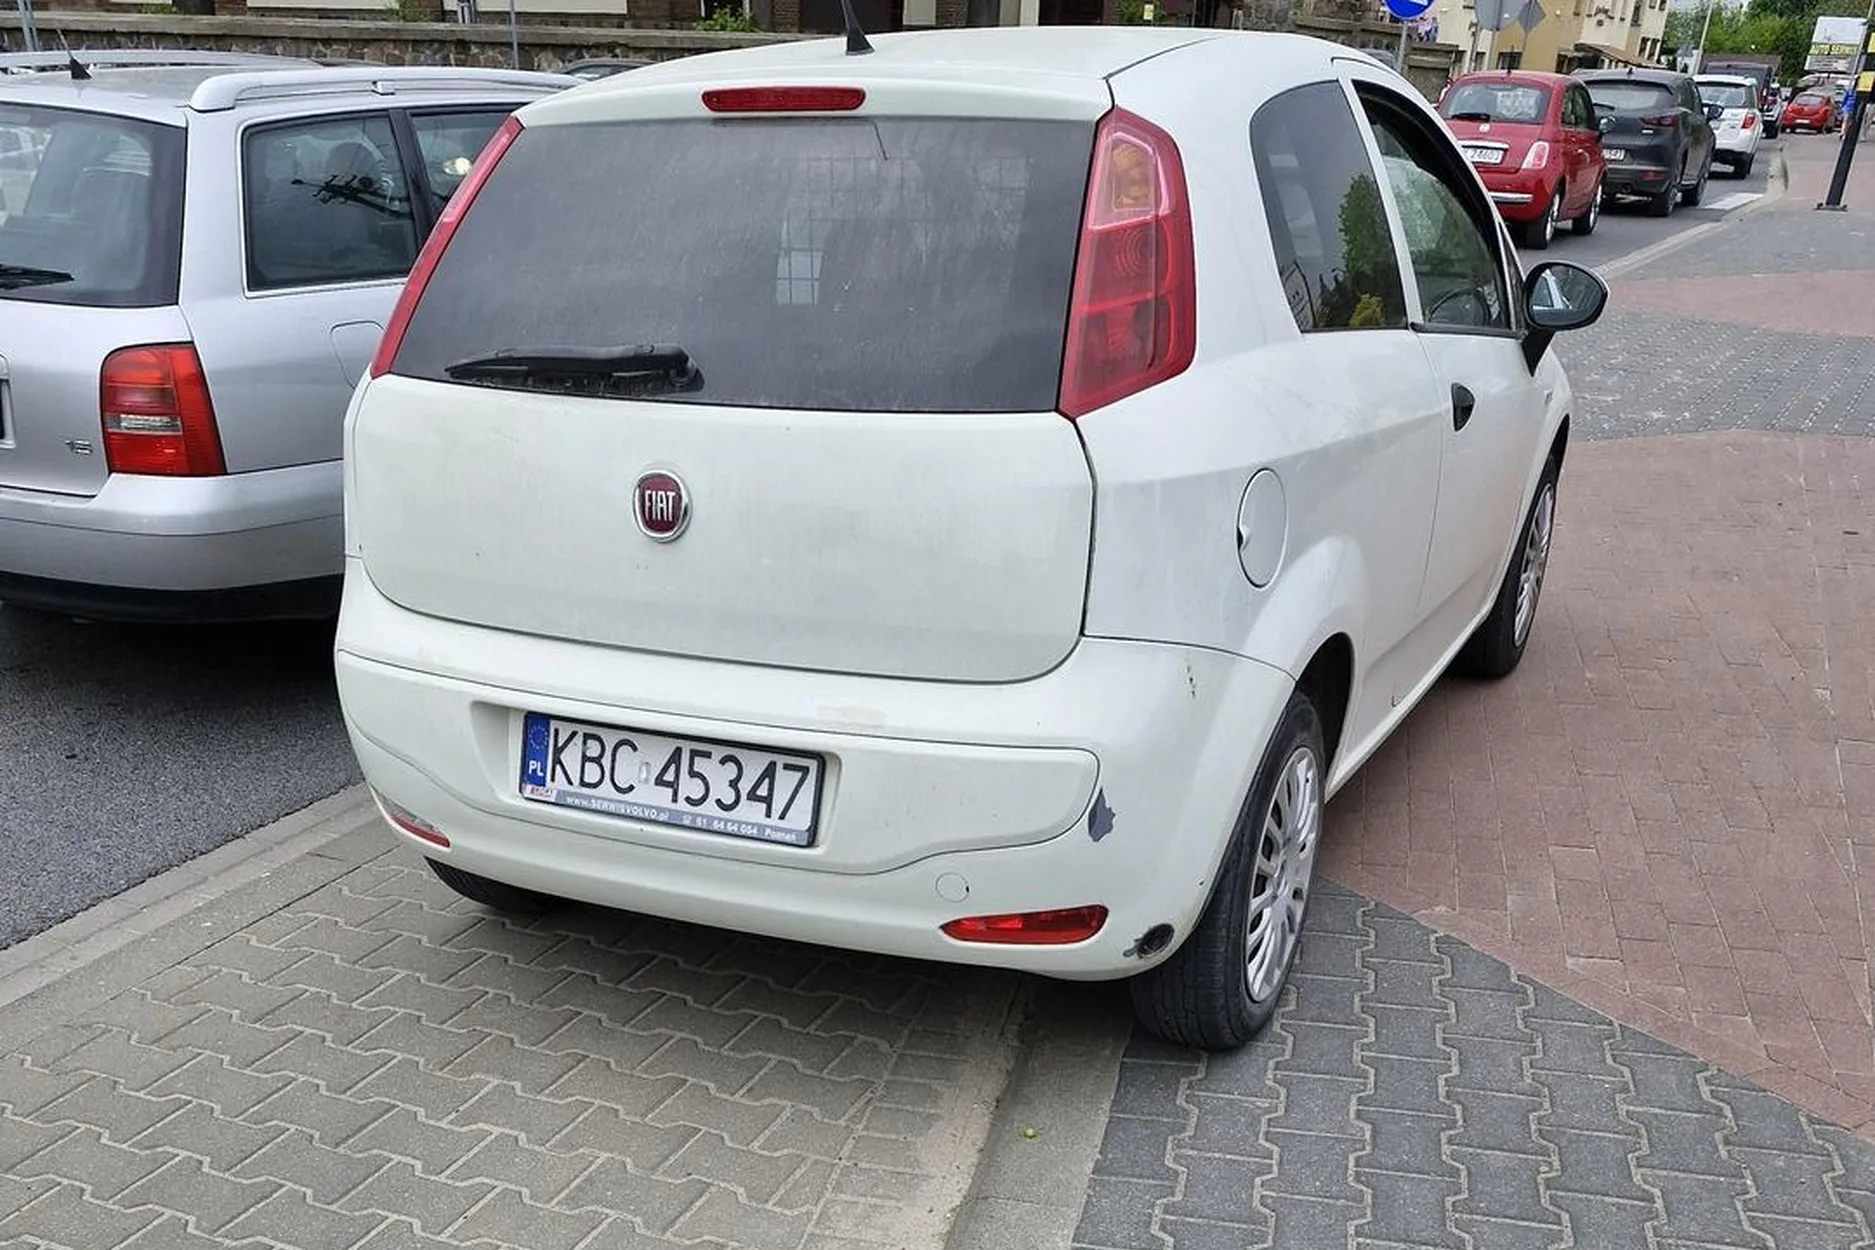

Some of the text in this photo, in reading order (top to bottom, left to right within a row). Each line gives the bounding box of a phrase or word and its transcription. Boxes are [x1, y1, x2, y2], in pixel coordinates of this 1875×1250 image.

[645, 489, 676, 521] FIAT
[528, 760, 544, 776] PL
[550, 727, 810, 820] KBC 45347
